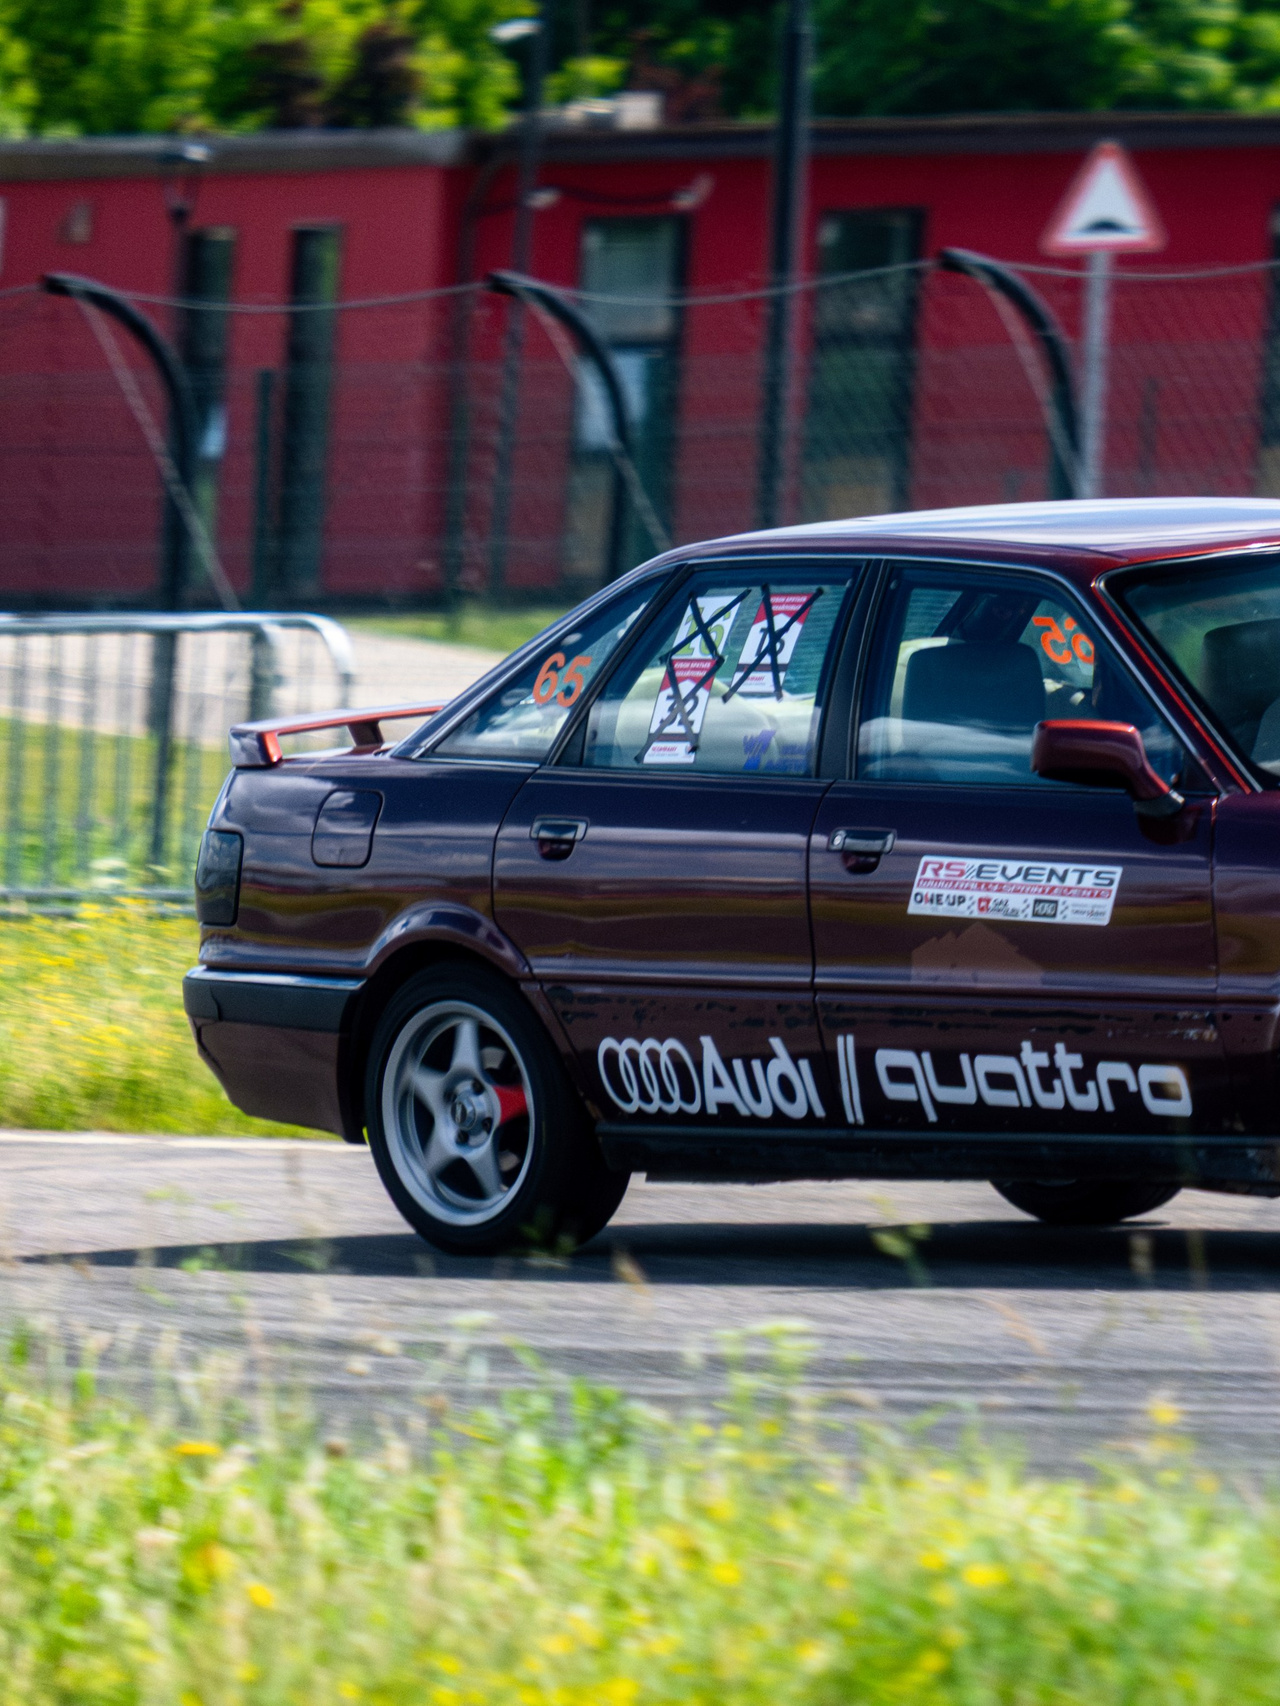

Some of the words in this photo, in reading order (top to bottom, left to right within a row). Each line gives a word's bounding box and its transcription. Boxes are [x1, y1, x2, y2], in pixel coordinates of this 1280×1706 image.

[532, 652, 592, 708] 65
[921, 861, 967, 877] RS
[975, 863, 1117, 887] EVENTS
[700, 1035, 826, 1118] Audi
[875, 1040, 1193, 1122] quattro
